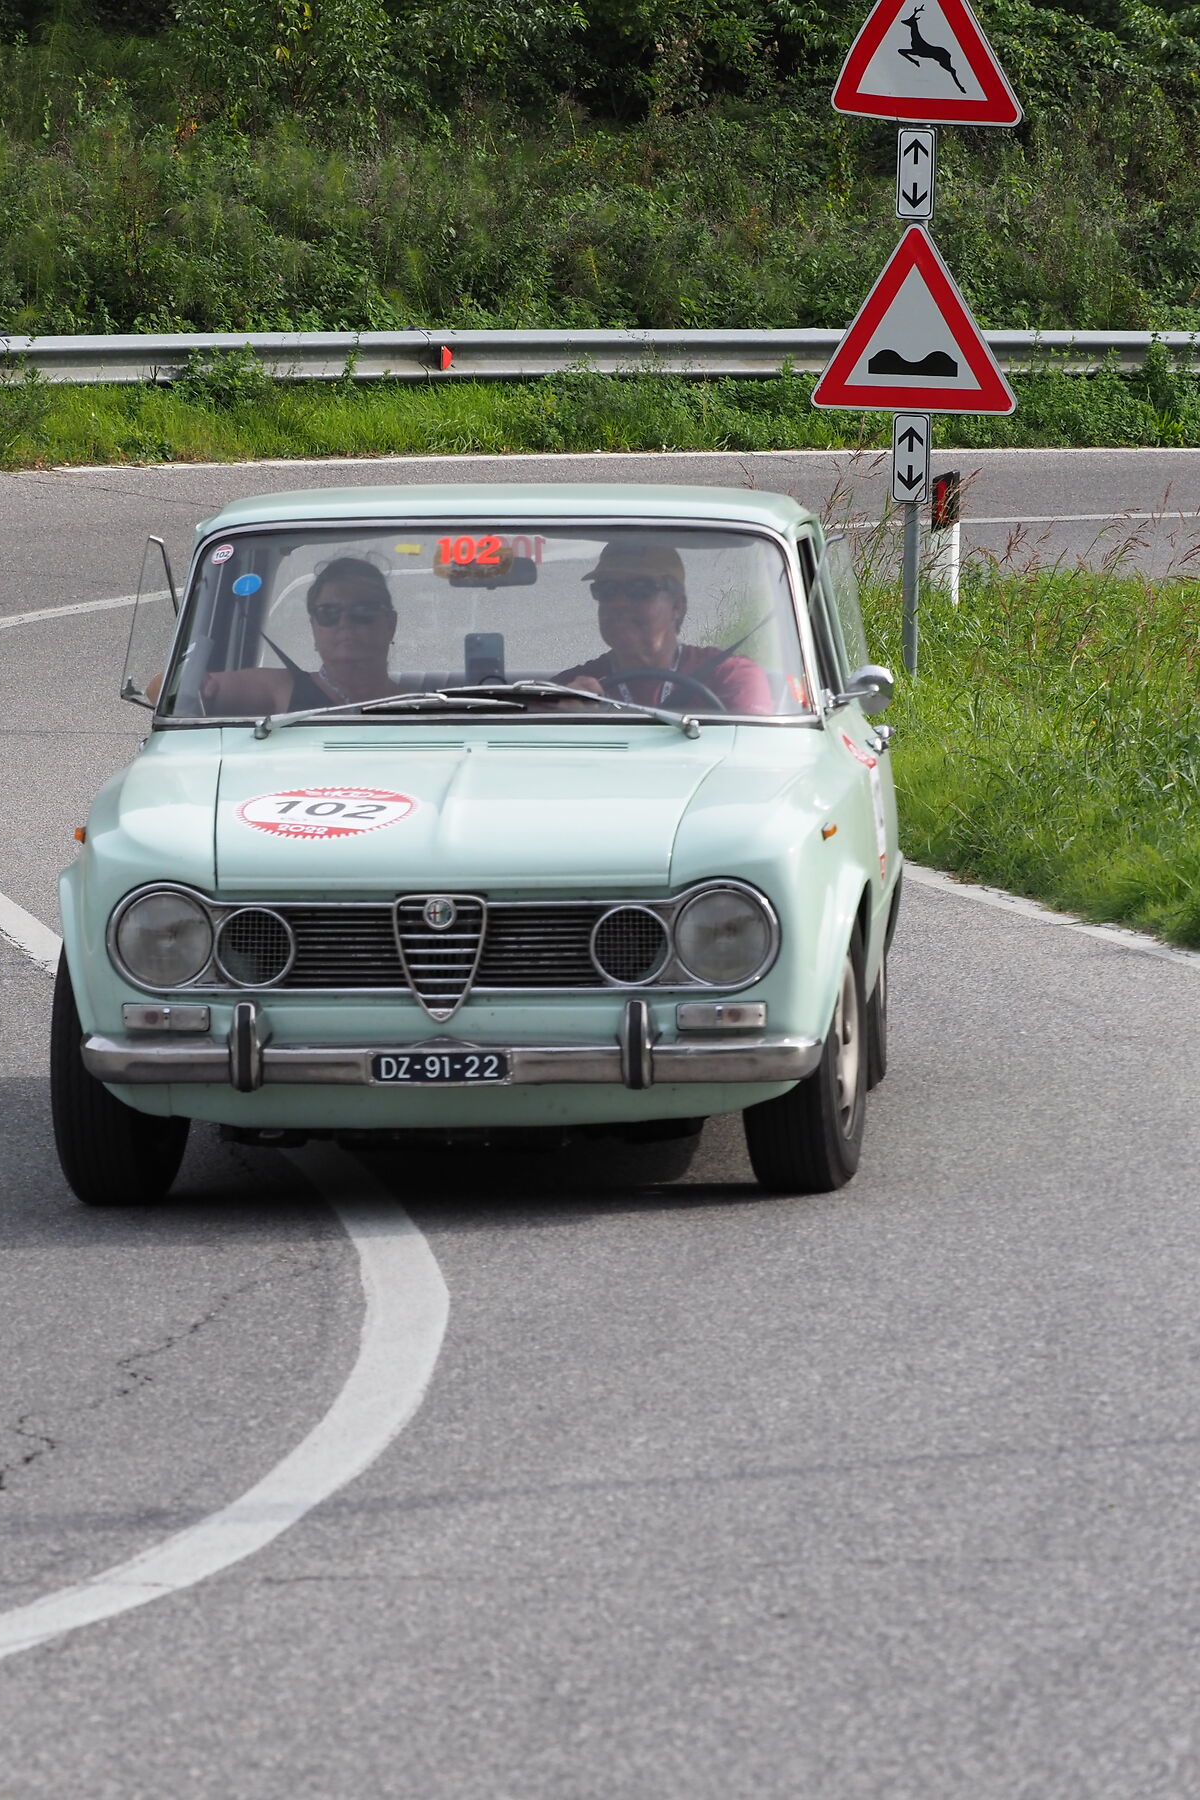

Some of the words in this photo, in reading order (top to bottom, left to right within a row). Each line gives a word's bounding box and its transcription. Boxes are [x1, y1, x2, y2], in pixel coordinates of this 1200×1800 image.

[215, 550, 231, 559] 102
[437, 535, 502, 565] 102
[275, 800, 388, 820] 102
[277, 823, 328, 834] 2022
[380, 1056, 499, 1079] DZ-91-22
